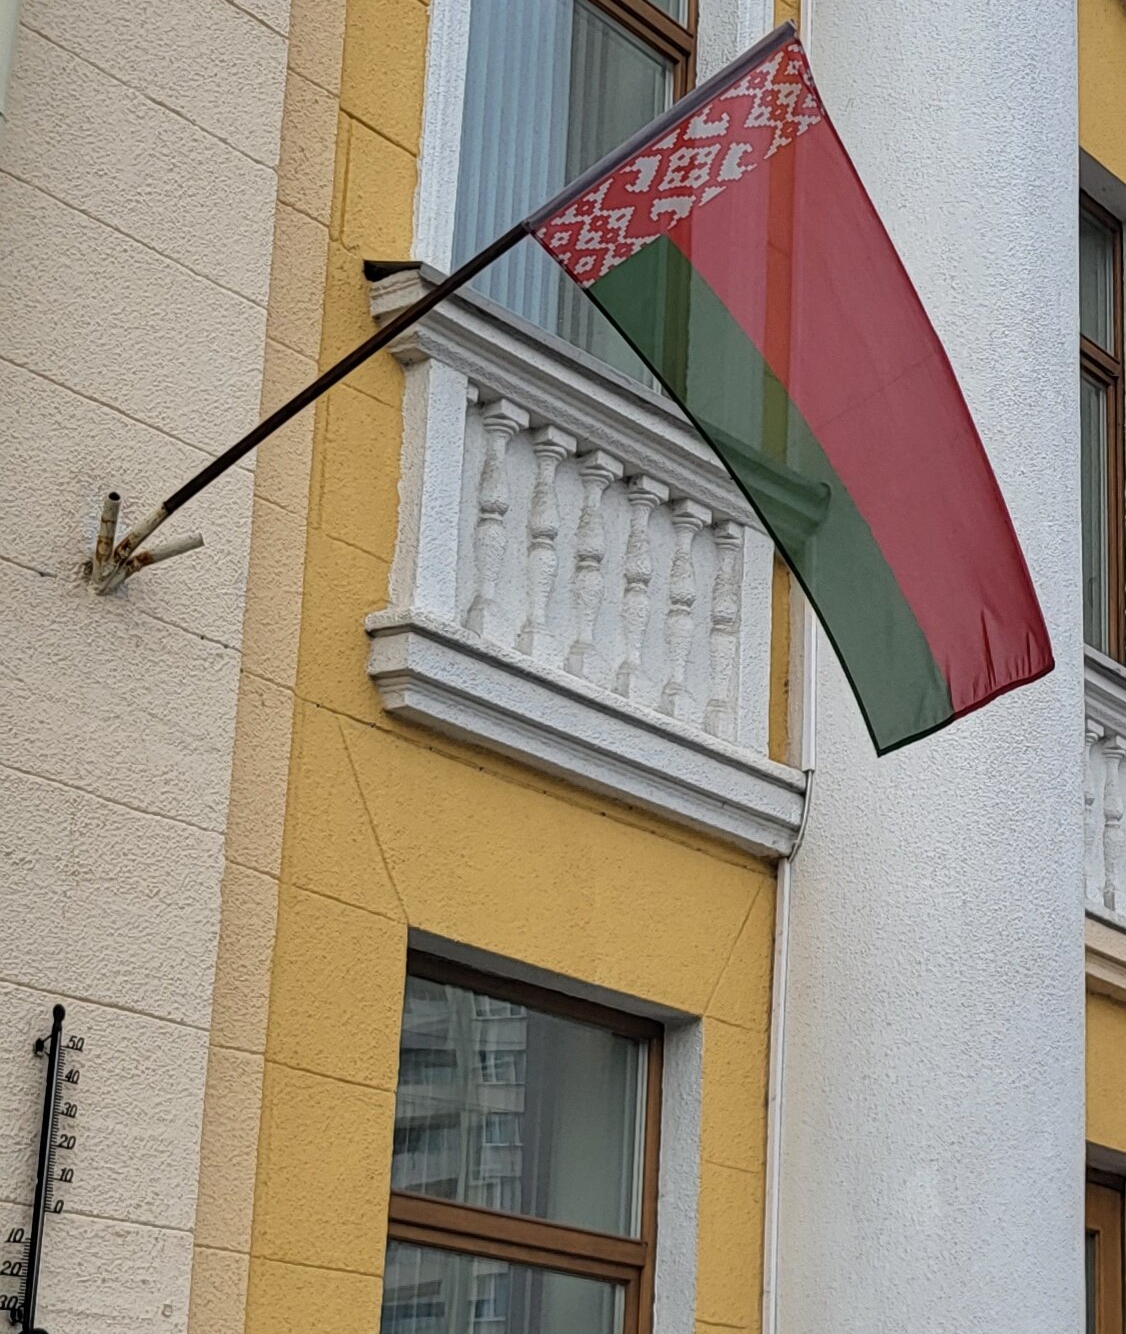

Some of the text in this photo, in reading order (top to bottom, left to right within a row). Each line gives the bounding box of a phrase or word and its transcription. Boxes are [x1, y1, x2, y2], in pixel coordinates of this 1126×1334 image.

[67, 1035, 85, 1052] 50
[65, 1069, 80, 1084] 40
[62, 1102, 78, 1118] 30
[58, 1134, 77, 1150] 20
[59, 1167, 74, 1183] 10
[53, 1199, 64, 1214] 0
[6, 1228, 24, 1243] 10
[0, 1260, 22, 1276] 20
